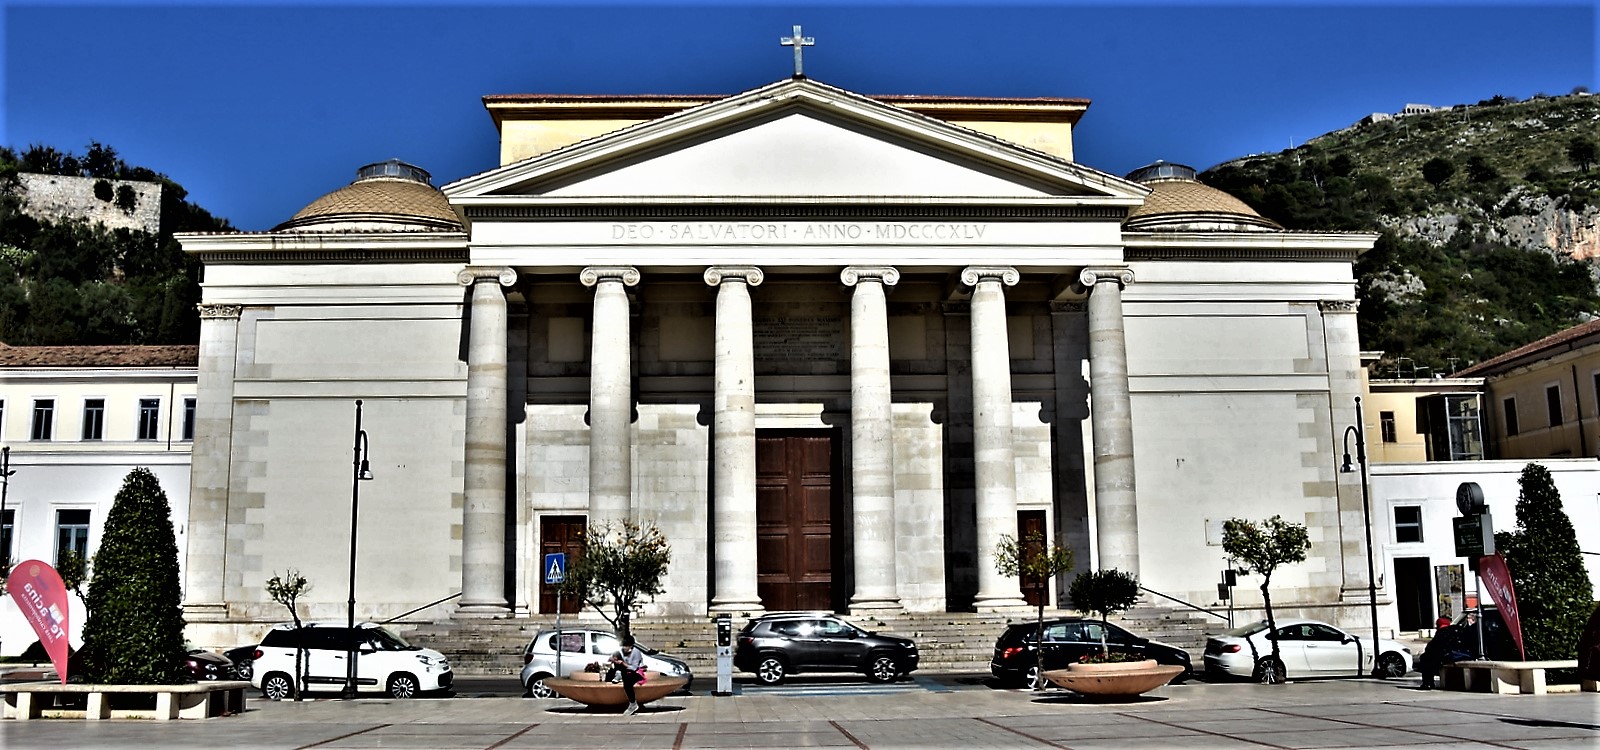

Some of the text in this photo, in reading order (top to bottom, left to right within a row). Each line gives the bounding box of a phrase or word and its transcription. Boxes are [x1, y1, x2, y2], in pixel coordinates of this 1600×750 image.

[611, 224, 987, 240] DEO SALVATORI ANNO MDCCCXLV
